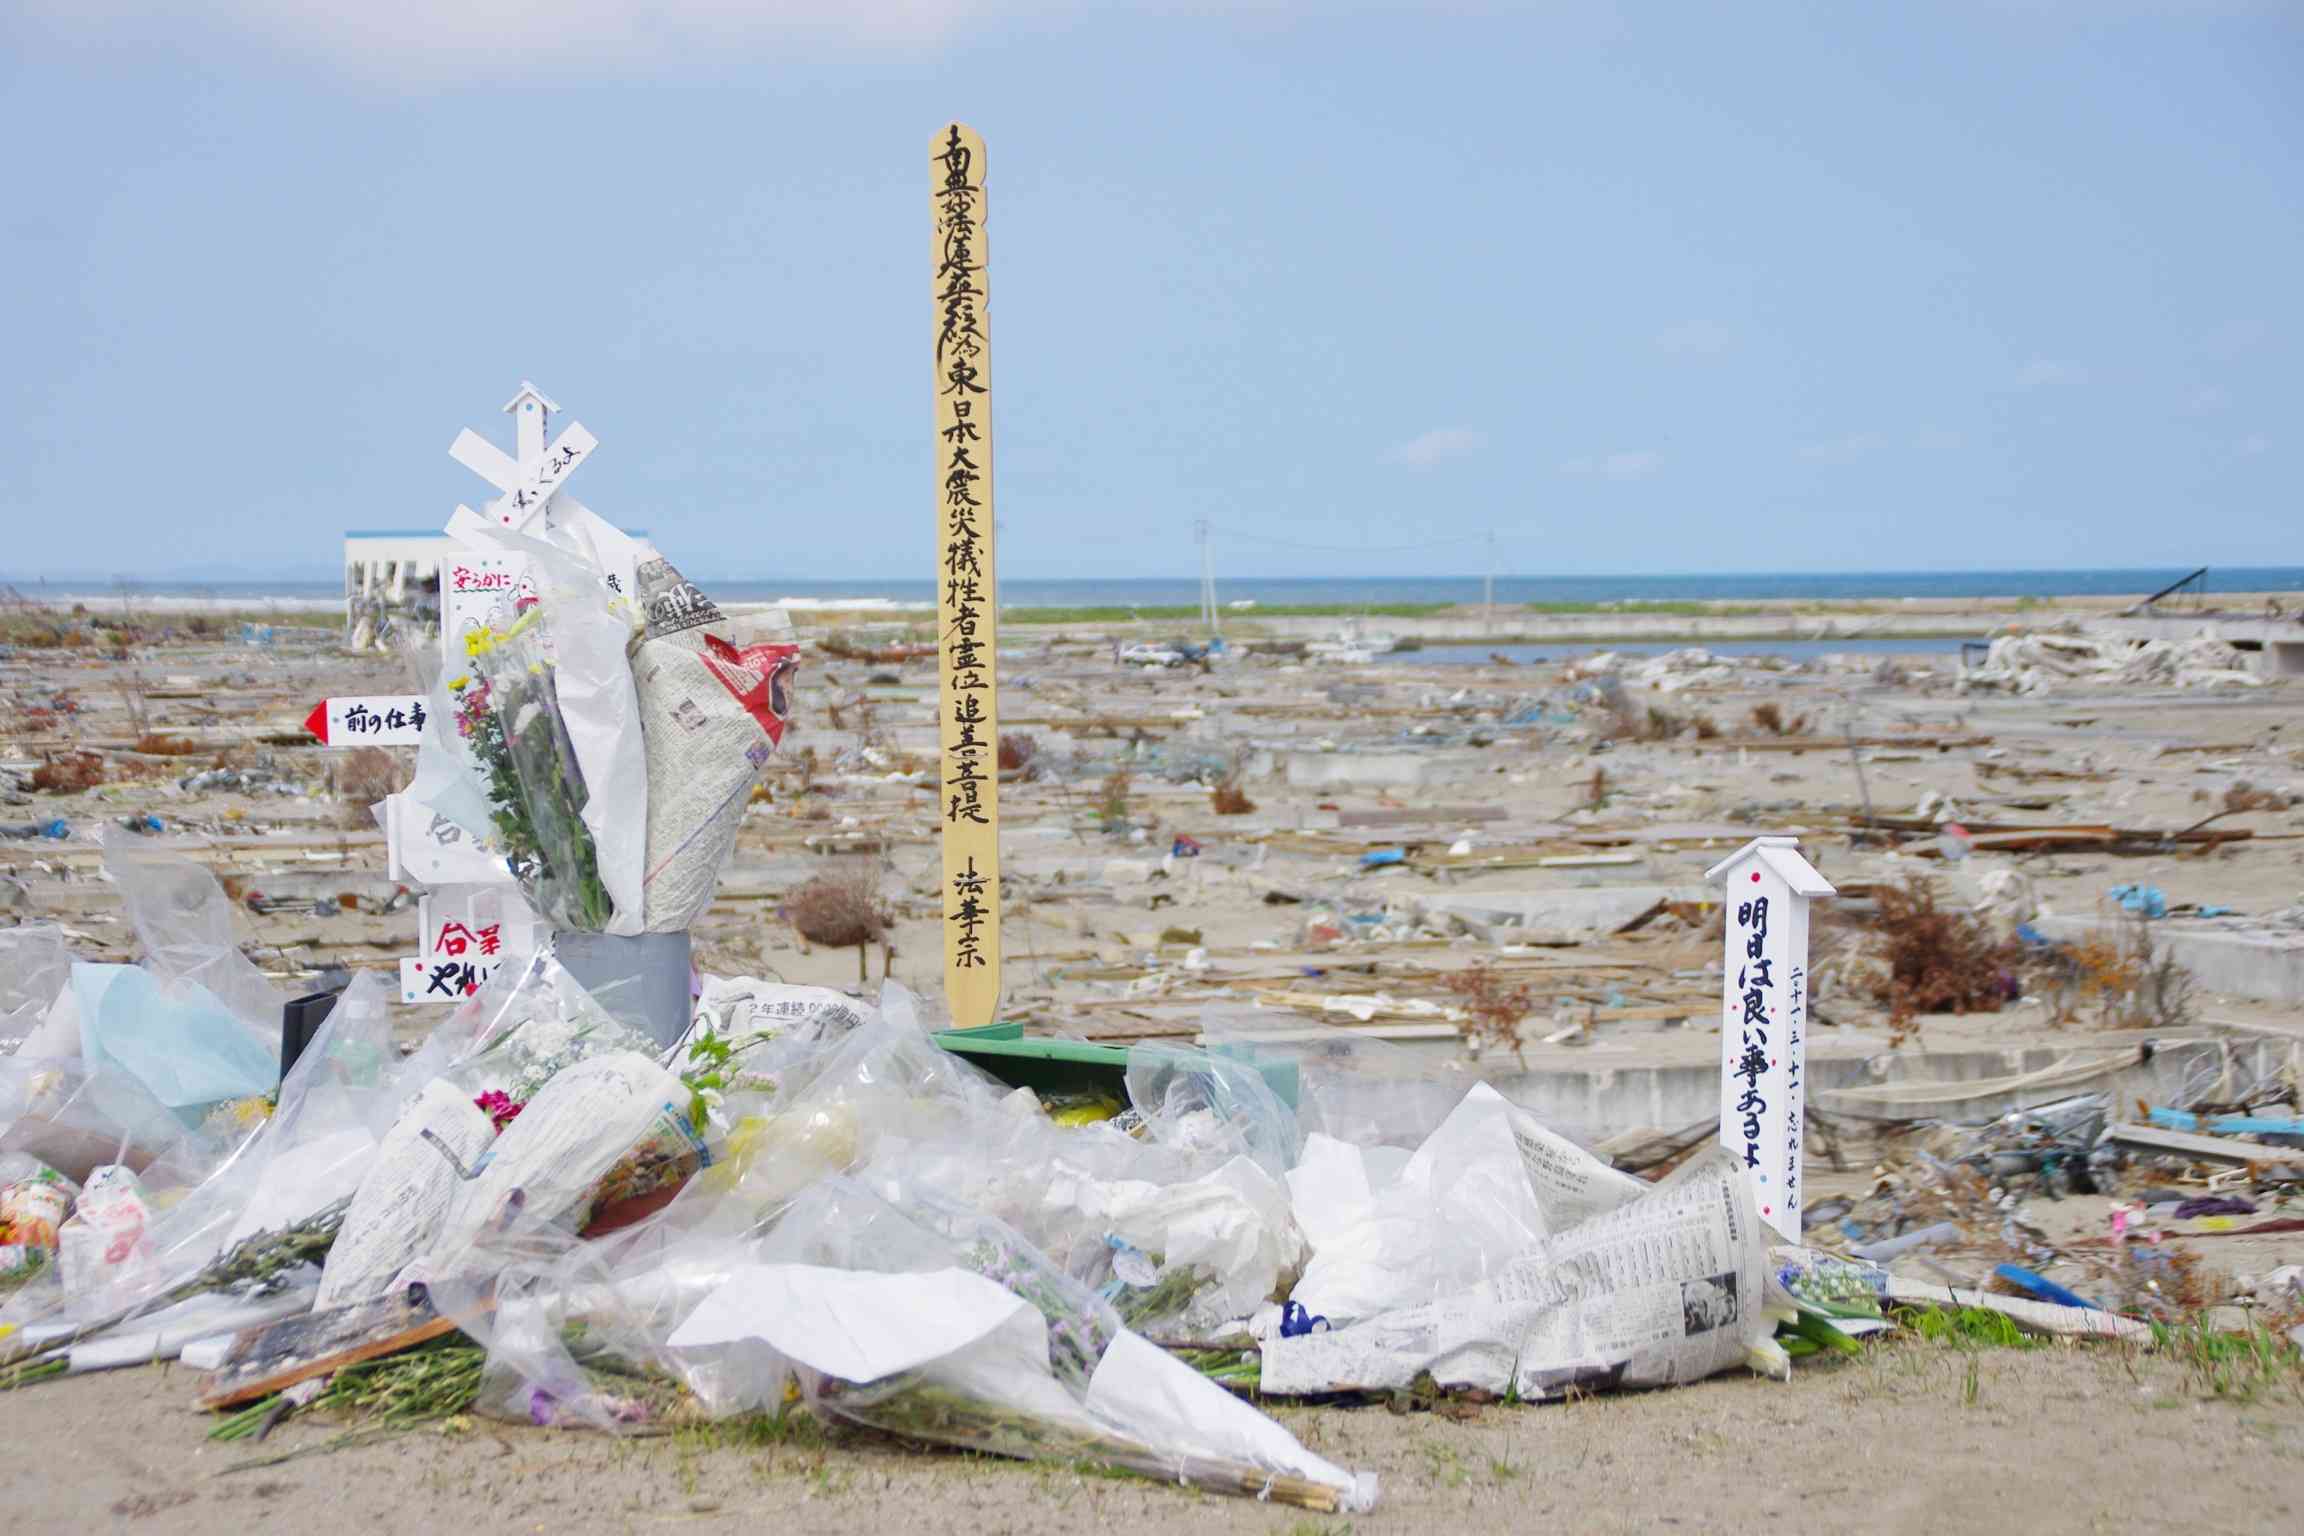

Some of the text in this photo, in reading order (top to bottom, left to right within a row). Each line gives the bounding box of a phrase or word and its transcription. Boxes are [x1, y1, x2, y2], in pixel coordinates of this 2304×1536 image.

[949, 856, 991, 968] 法華宗
[1733, 896, 1774, 1169] 明日は良い事あるよ
